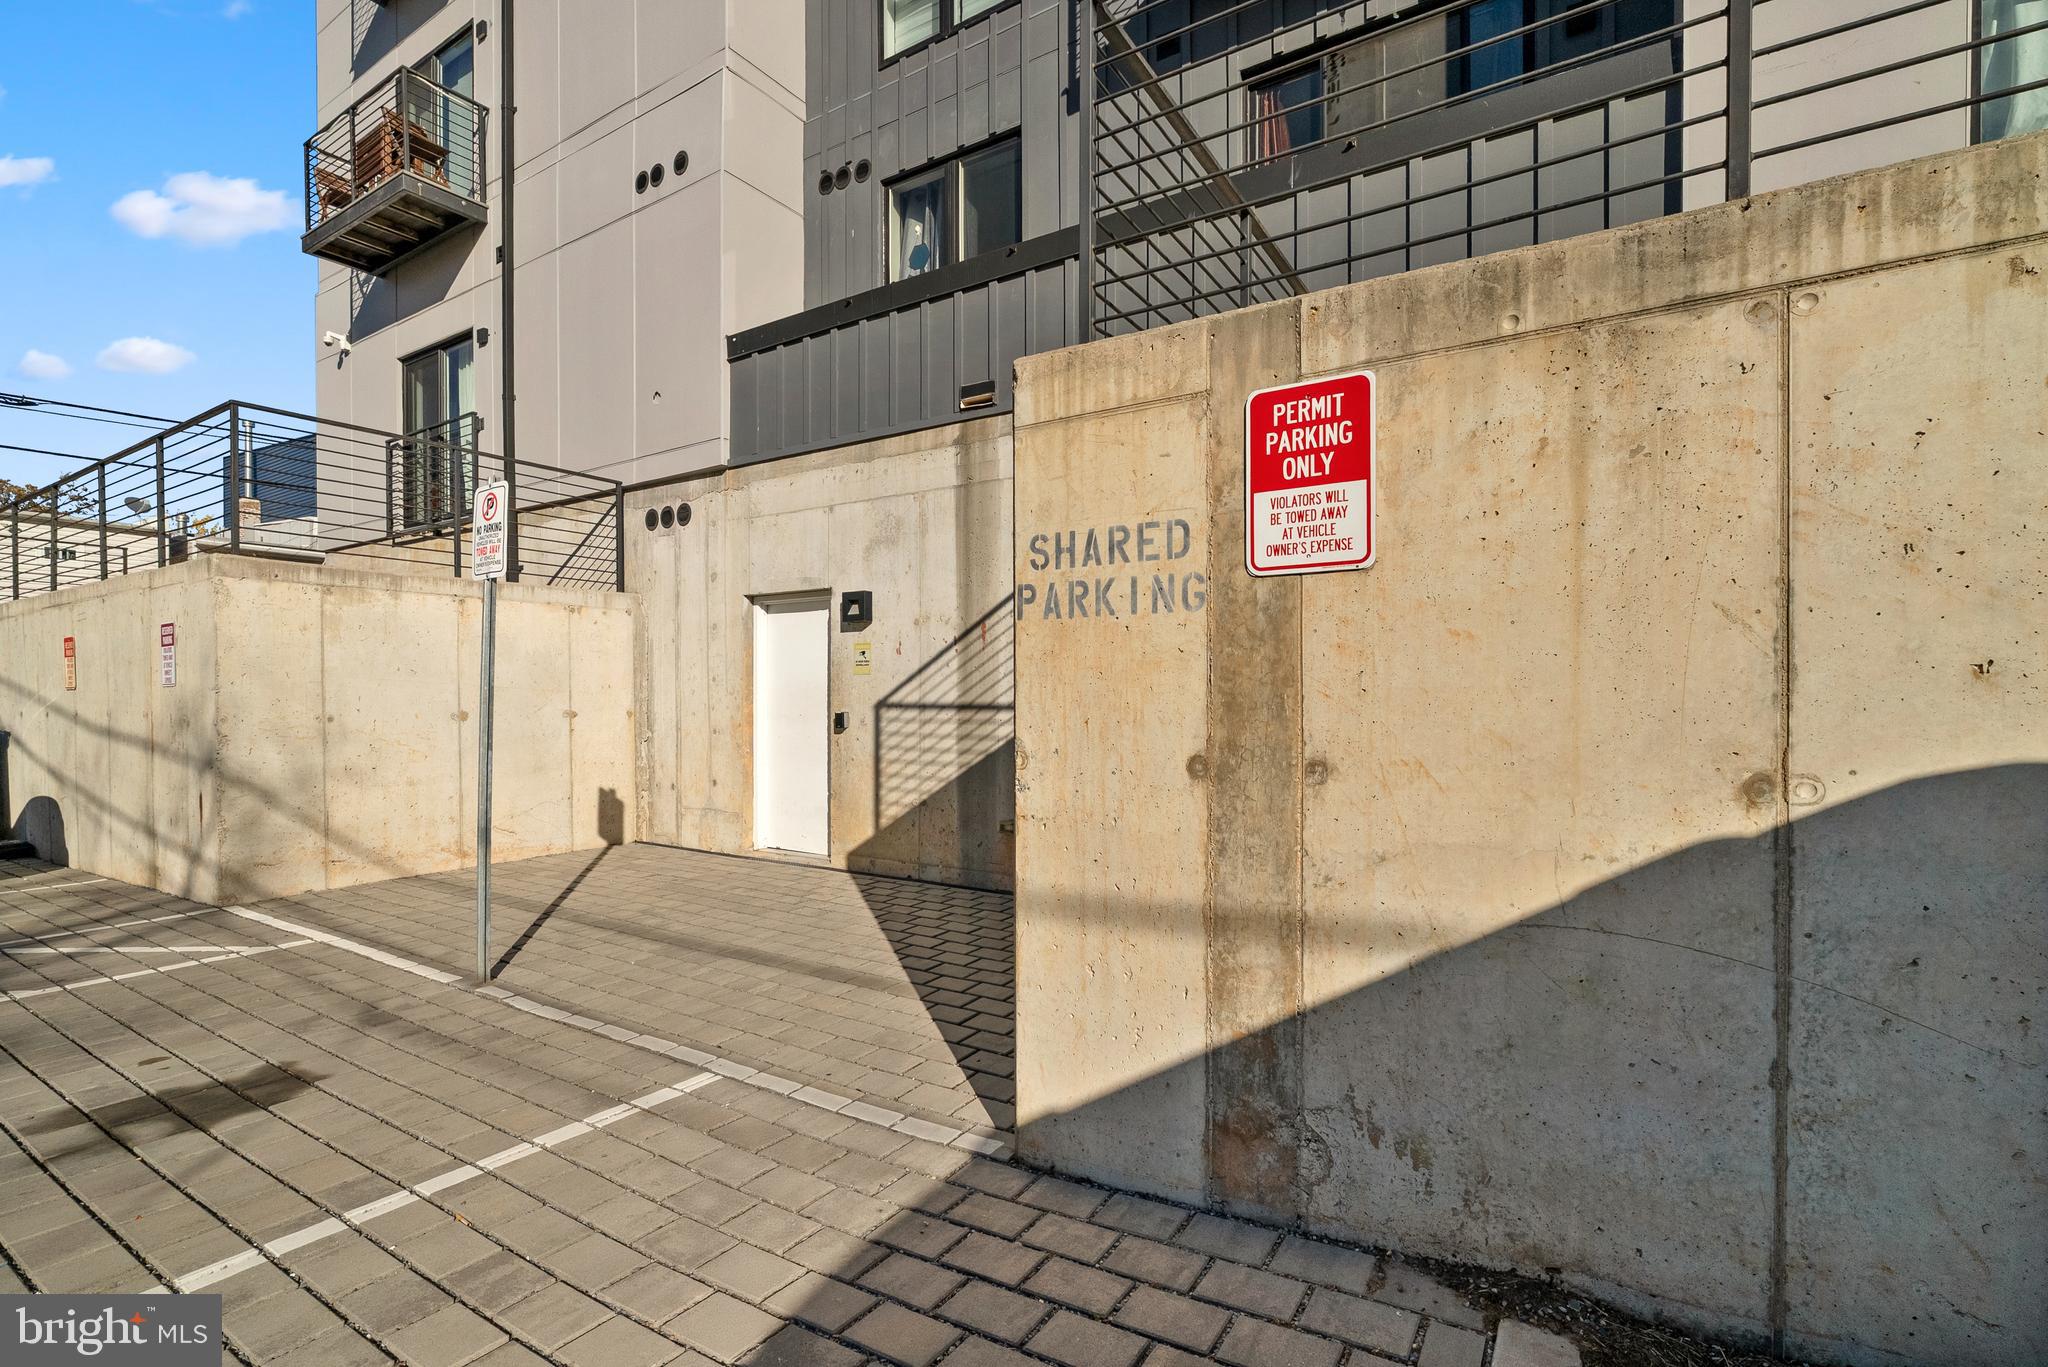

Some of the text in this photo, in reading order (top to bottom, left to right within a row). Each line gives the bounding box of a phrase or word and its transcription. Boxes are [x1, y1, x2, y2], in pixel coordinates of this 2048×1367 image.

[1273, 393, 1344, 427] PERMIT
[1266, 420, 1353, 455] PARKING
[1282, 451, 1335, 480] ONLY
[1270, 489, 1349, 510] VIOLATORS WILL
[1270, 505, 1348, 526] BE TOWED AWAY
[476, 522, 502, 536] NO PARKING
[1282, 523, 1337, 540] AT VEHICLE
[1029, 518, 1191, 571] SHARED
[1266, 537, 1353, 557] OWNER'S EXPENSE
[1017, 571, 1207, 621] PARKING
